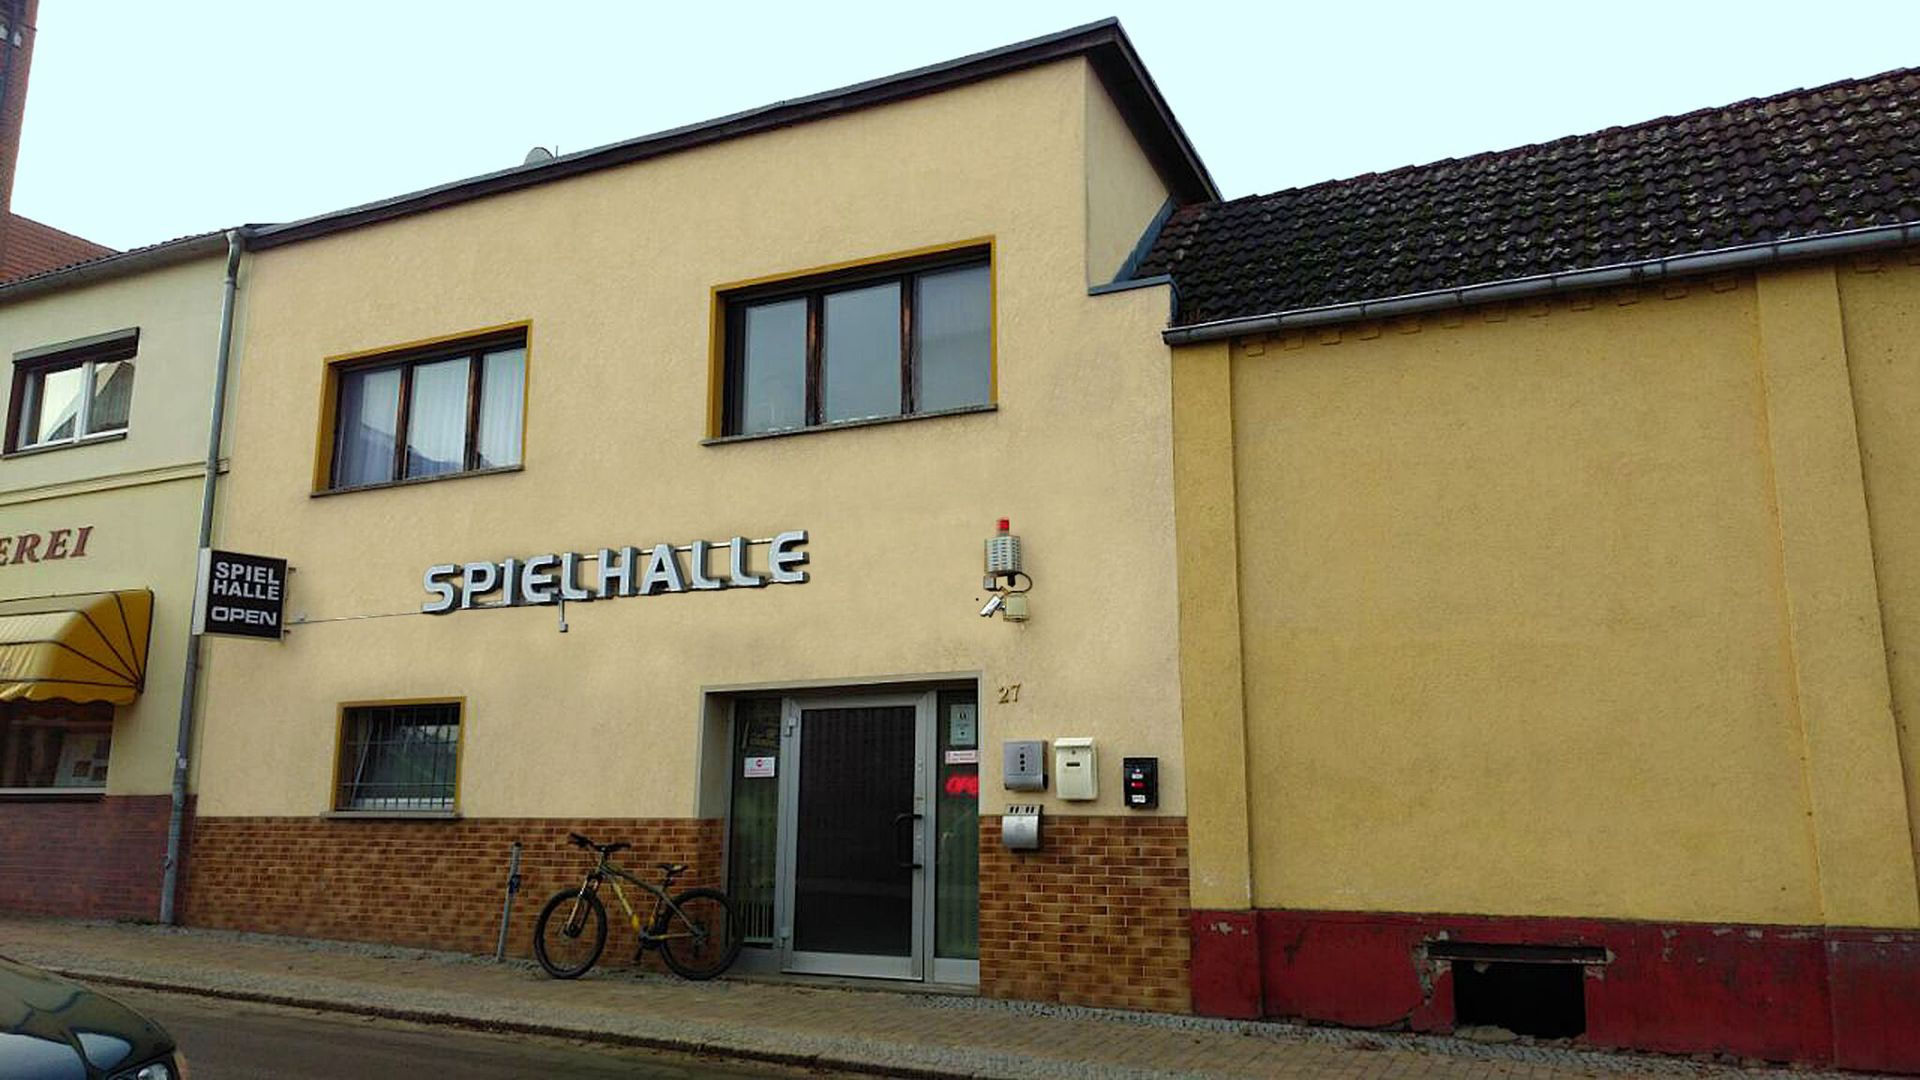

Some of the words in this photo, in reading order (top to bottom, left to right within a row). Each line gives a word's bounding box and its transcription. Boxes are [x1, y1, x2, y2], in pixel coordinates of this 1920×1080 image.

[215, 561, 280, 585] SPIEL
[422, 530, 808, 613] SPIELHALLE
[213, 579, 280, 601] HALLE
[211, 606, 277, 626] OPEN
[998, 683, 1021, 704] 27
